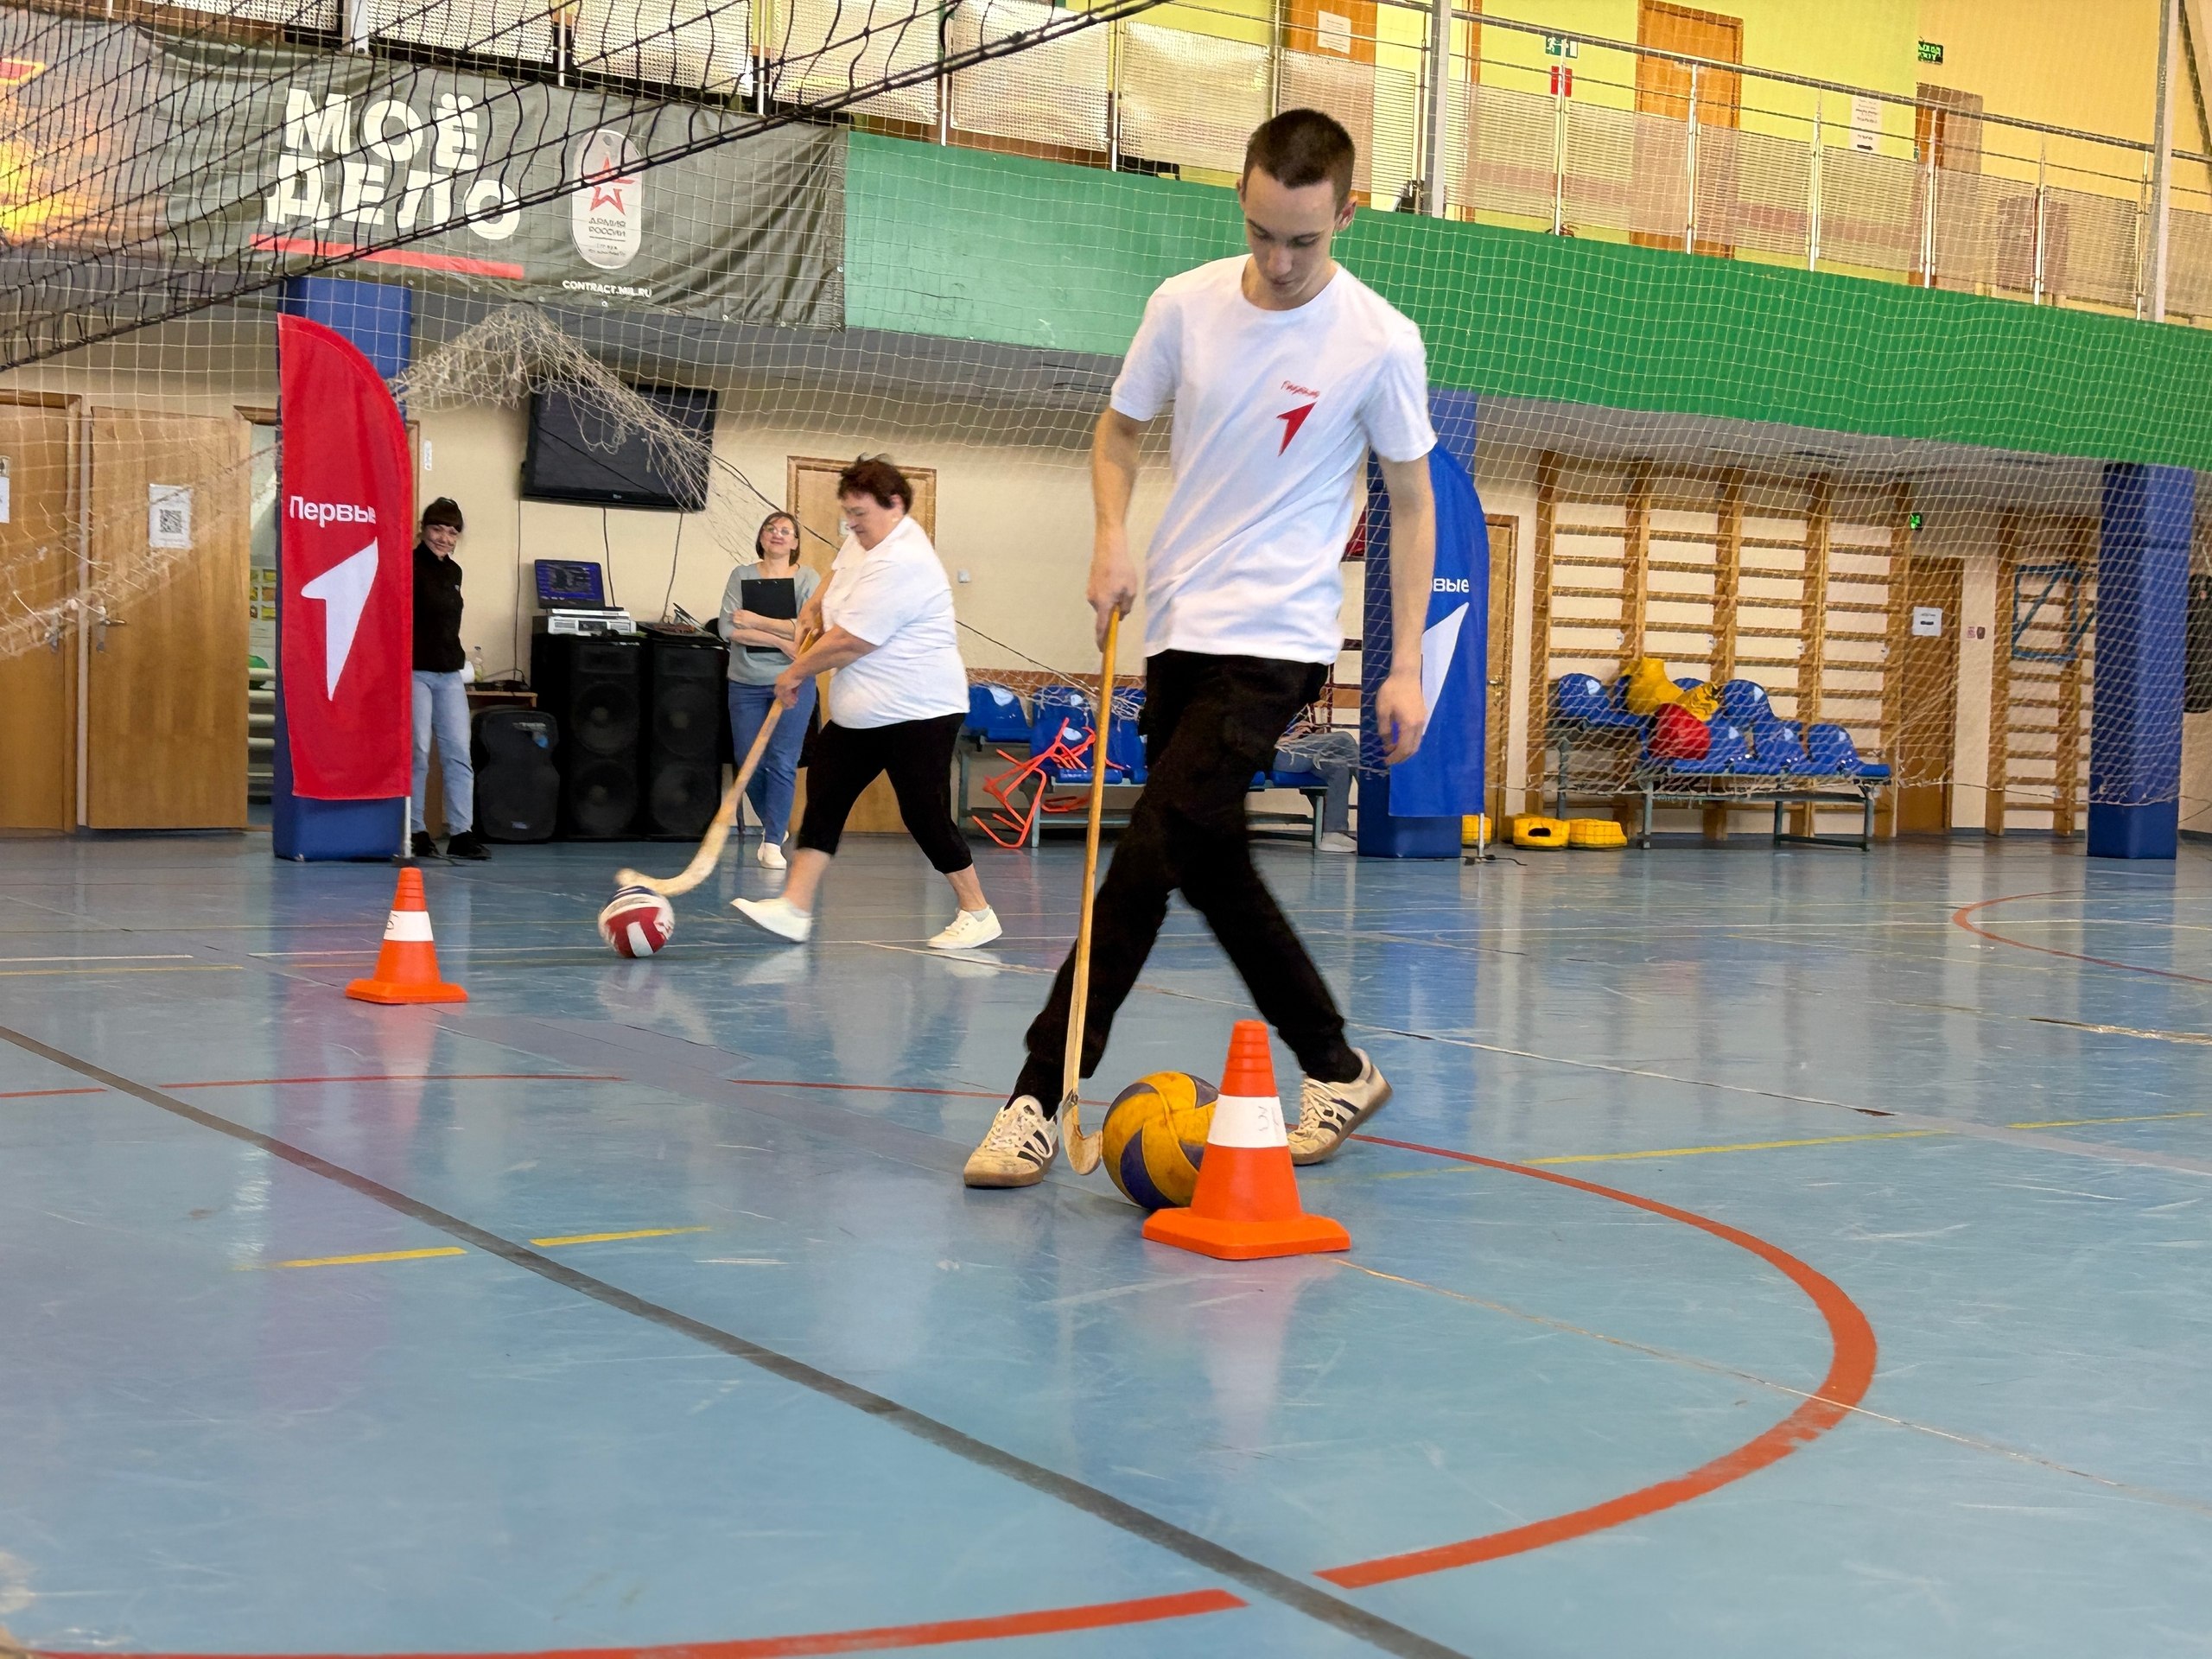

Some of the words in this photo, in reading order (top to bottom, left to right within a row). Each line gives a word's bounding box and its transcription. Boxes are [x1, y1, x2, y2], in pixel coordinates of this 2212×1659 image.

[286, 88, 478, 171] МОЁ
[267, 154, 521, 240] ДЕЛО
[562, 280, 653, 298] CONTRACT.MIL.RU
[1433, 577, 1470, 594] вые
